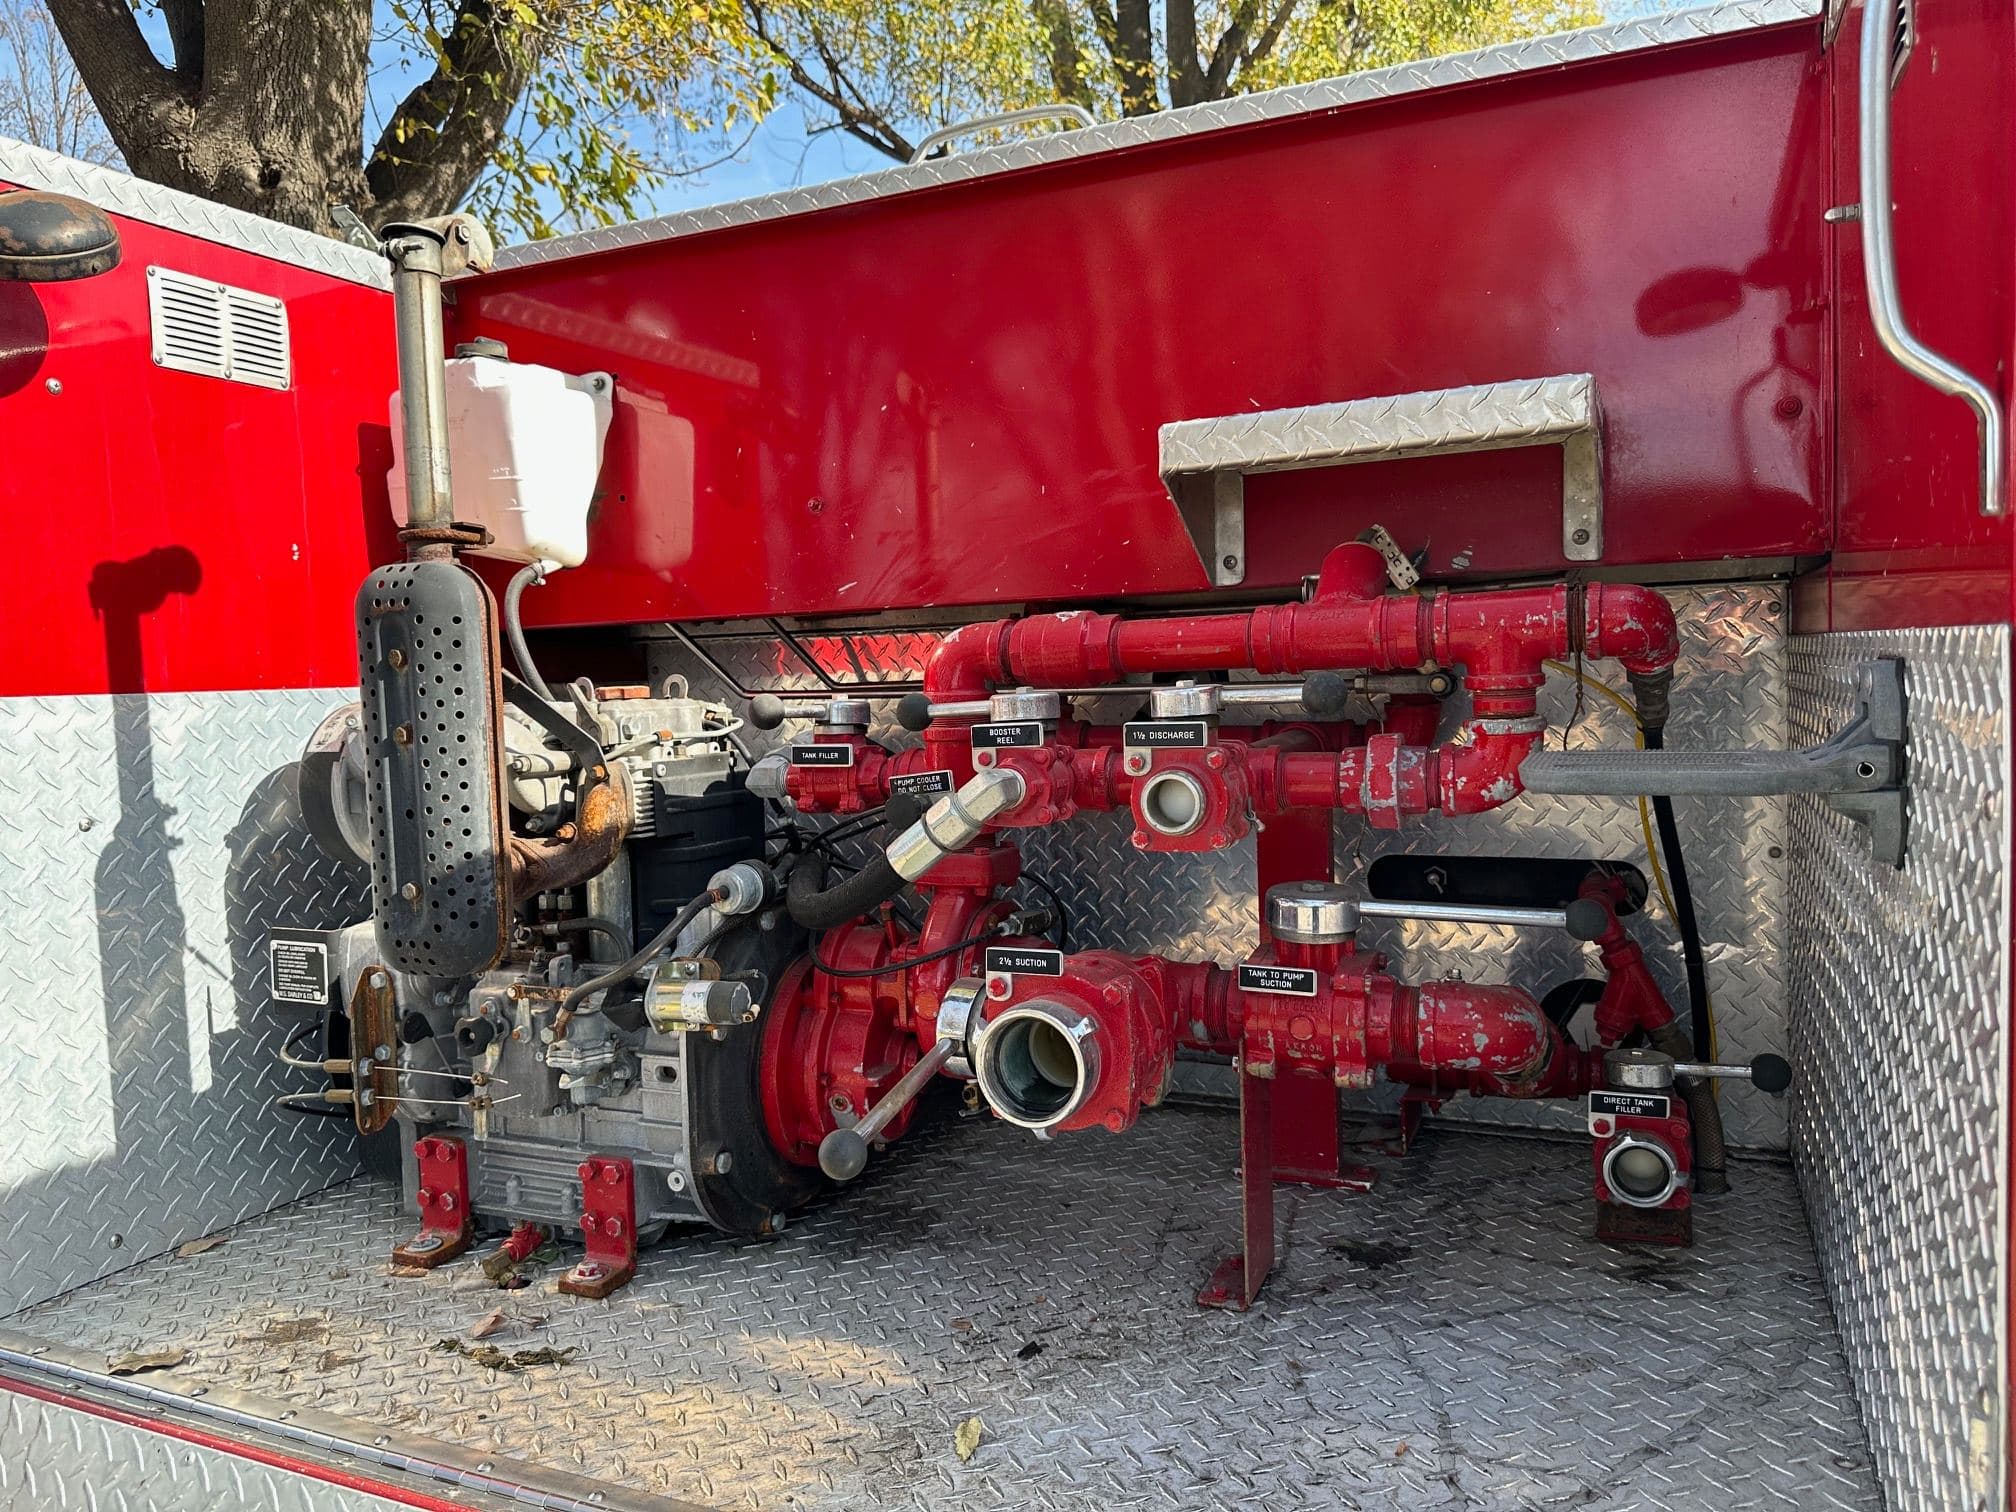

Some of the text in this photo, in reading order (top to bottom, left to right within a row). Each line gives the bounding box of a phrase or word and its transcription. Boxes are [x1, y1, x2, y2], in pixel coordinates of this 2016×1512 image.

[989, 728, 1021, 736] BOOSTER
[1149, 731, 1195, 739] DISCHARGE
[897, 775, 941, 787] PUMP COOLER
[908, 785, 920, 793] NOT
[922, 783, 943, 791] CLOSE
[1015, 958, 1047, 967] SUCTION
[1248, 969, 1305, 981] TANK TO PUMP
[1260, 978, 1292, 989] SUCTION
[1603, 1096, 1655, 1107] DIRECT TANK
[1615, 1105, 1642, 1114] FILLER
